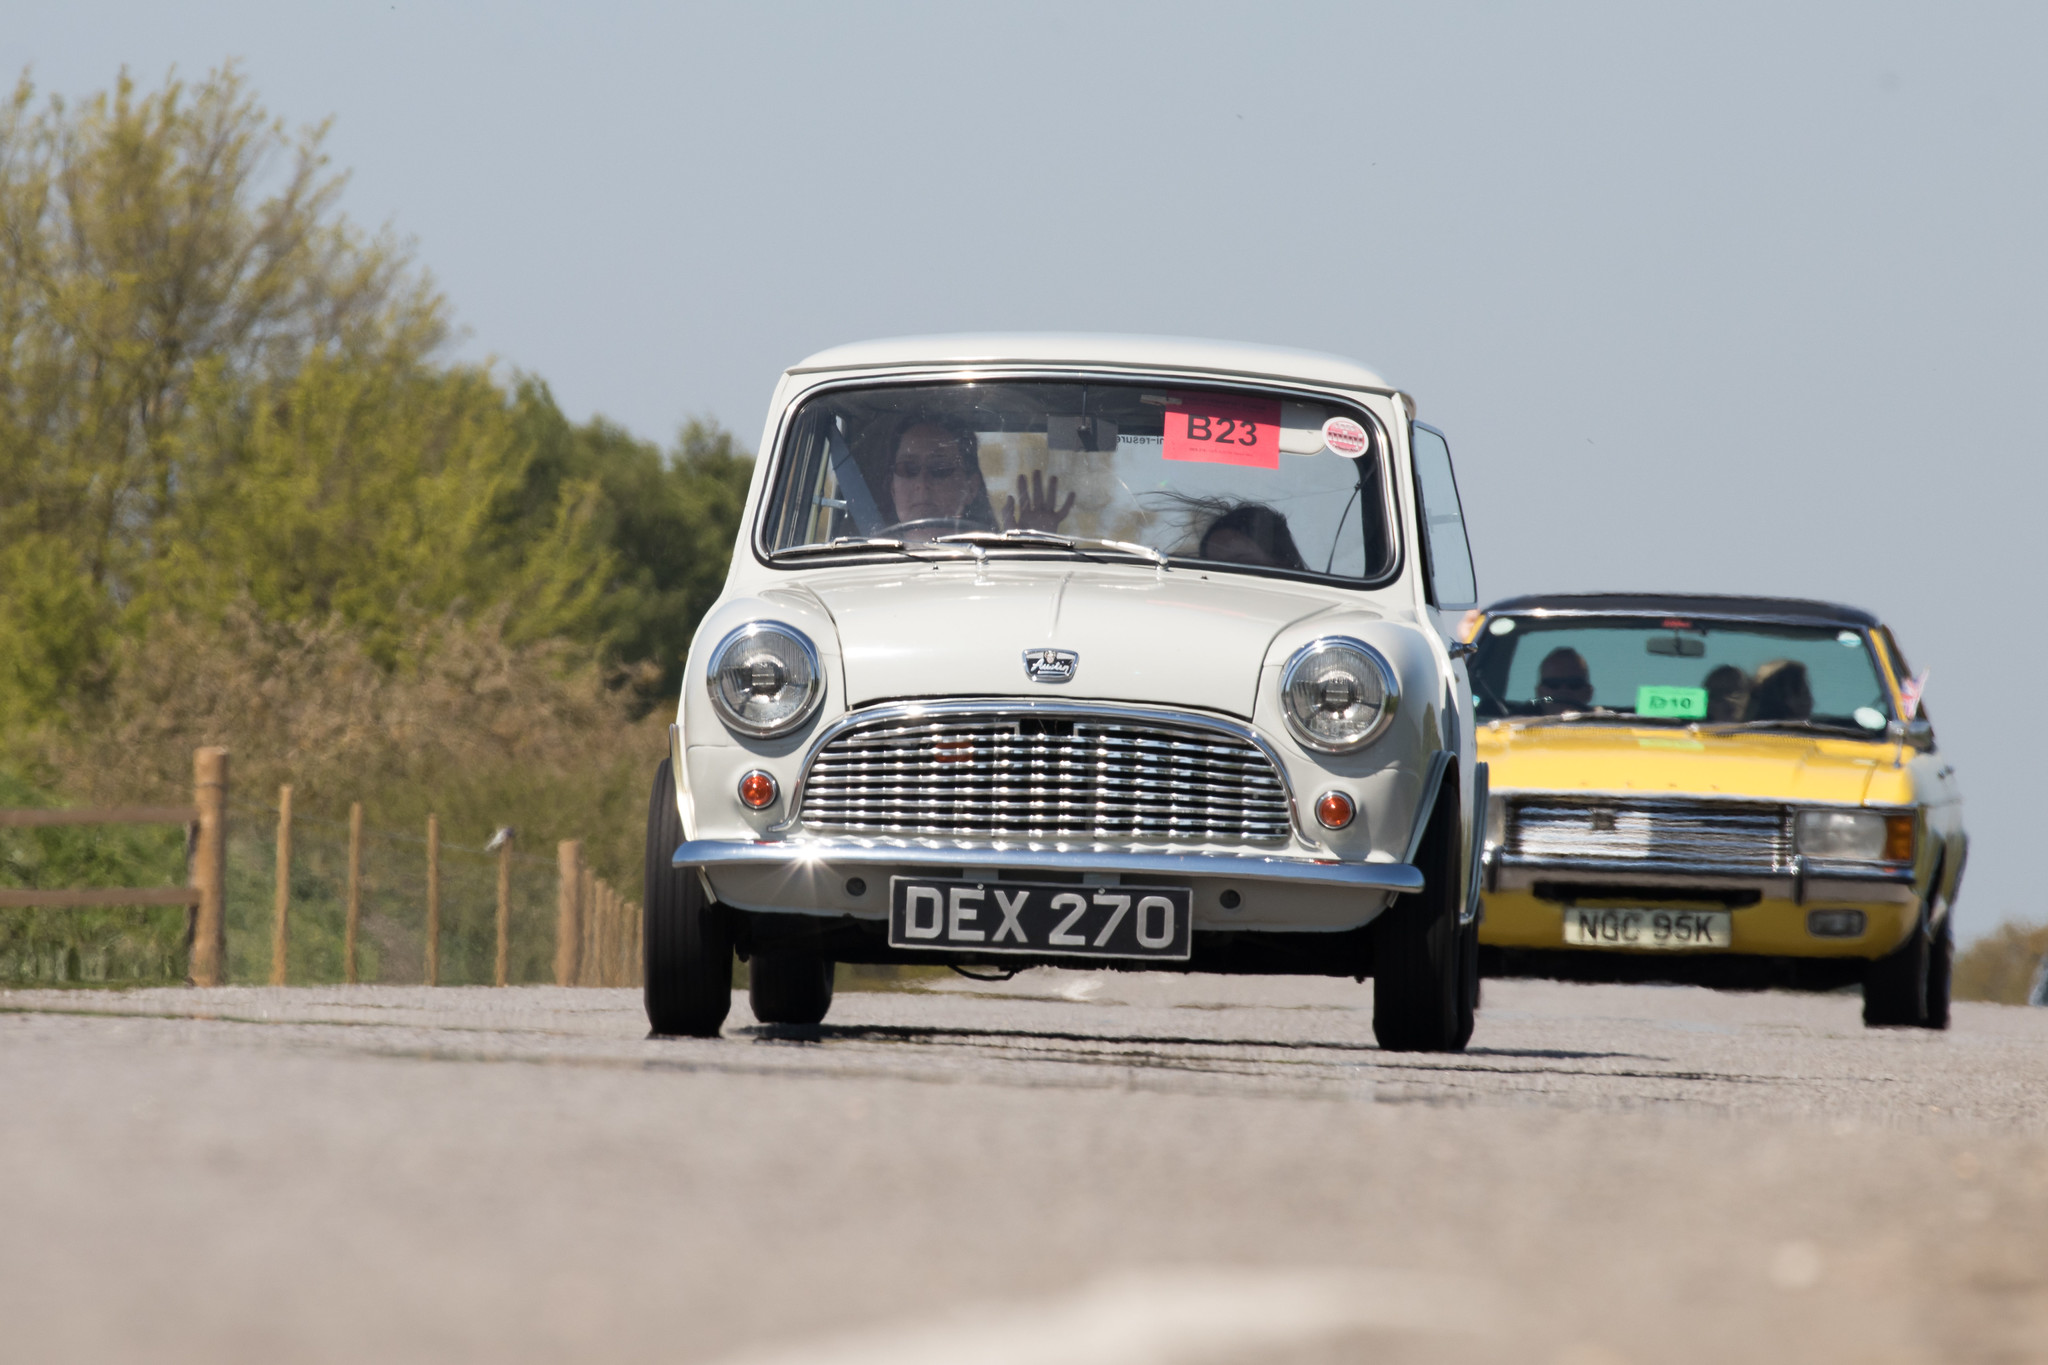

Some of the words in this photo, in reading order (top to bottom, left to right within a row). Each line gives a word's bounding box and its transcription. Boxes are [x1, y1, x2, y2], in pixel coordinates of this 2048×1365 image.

[1187, 413, 1257, 446] B23
[1030, 657, 1069, 676] Austin
[905, 886, 1030, 943] DEX
[1049, 892, 1175, 949] 270
[1653, 911, 1713, 942] 95K
